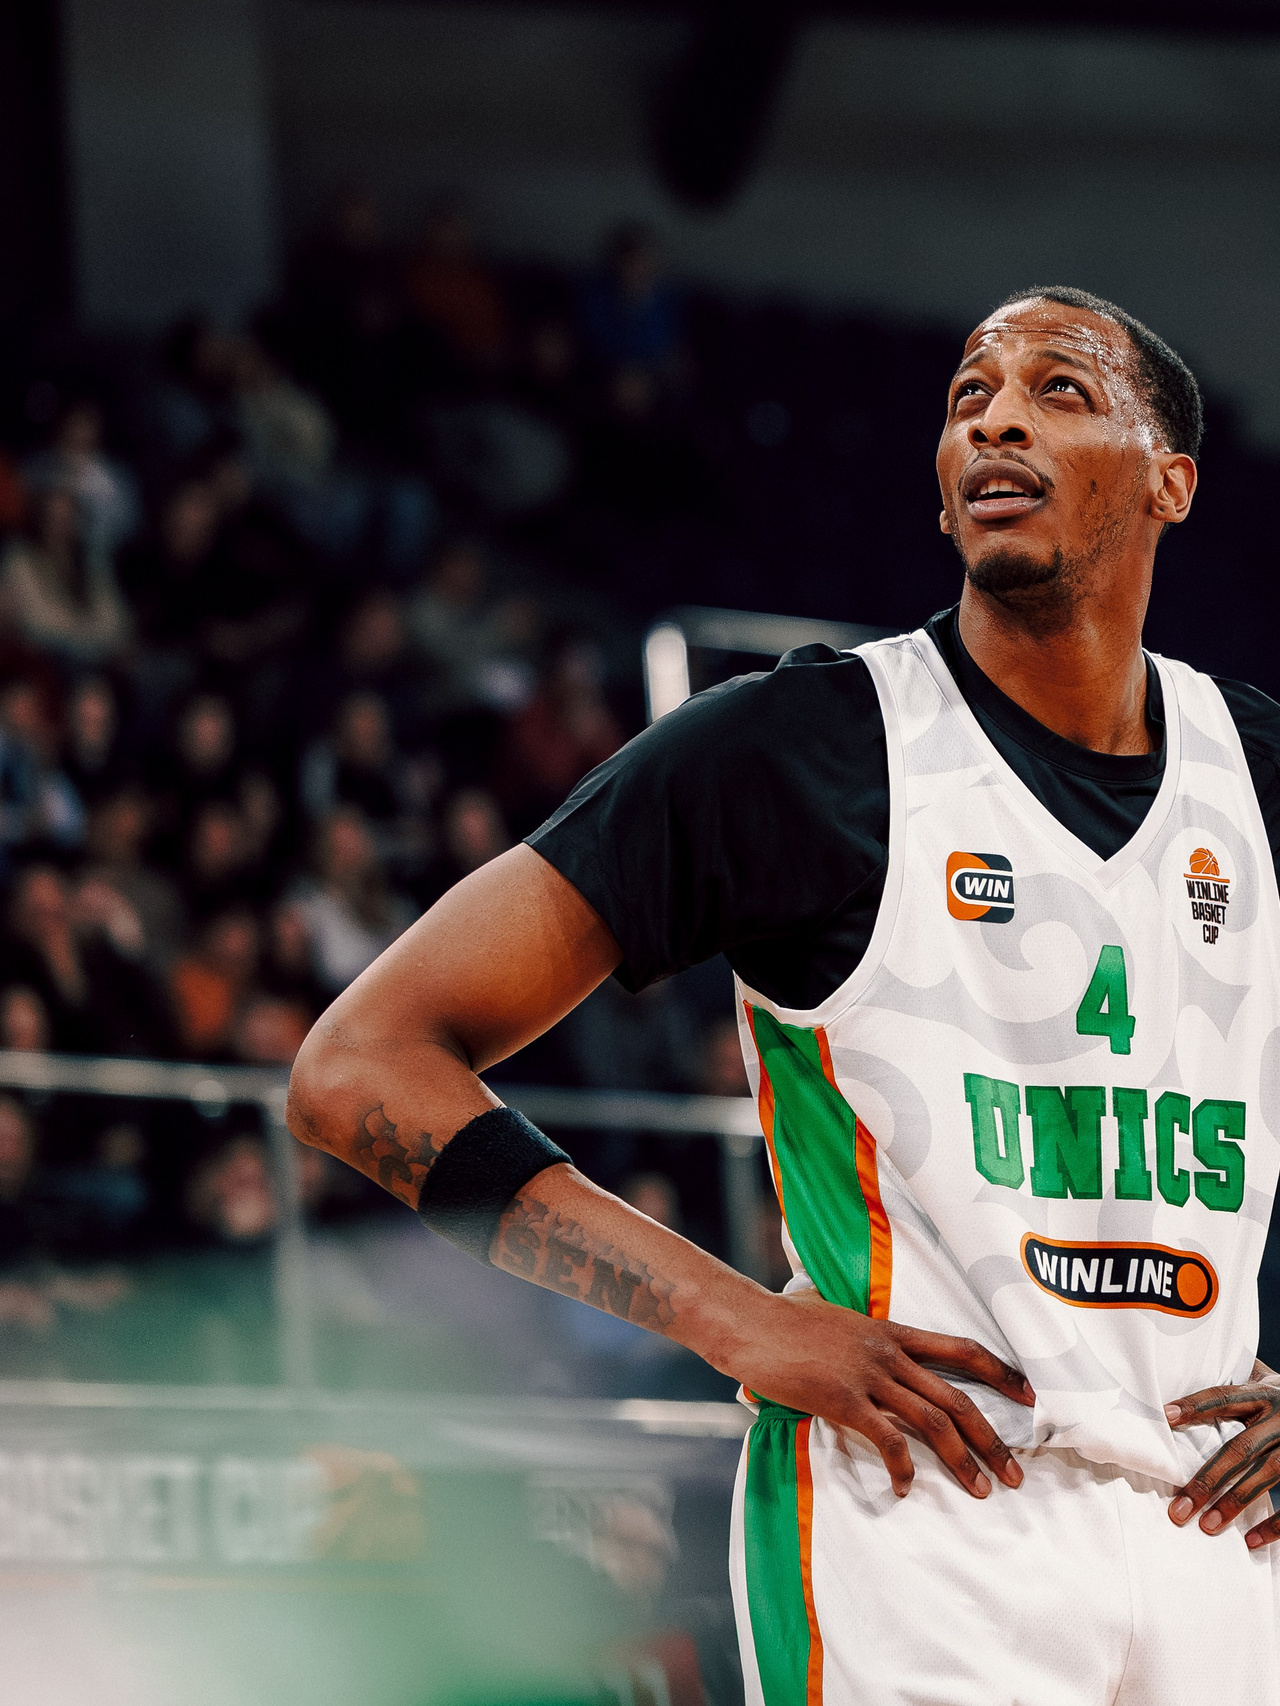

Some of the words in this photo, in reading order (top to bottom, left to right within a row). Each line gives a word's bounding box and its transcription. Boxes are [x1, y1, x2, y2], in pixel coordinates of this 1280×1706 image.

[963, 874, 1010, 900] WIN
[1186, 880, 1229, 904] WINLINE
[1191, 901, 1226, 925] BASKET
[1203, 924, 1219, 945] CUP
[1076, 945, 1136, 1055] 4
[963, 1072, 1246, 1214] UNICS
[1033, 1247, 1174, 1299] WINLINE
